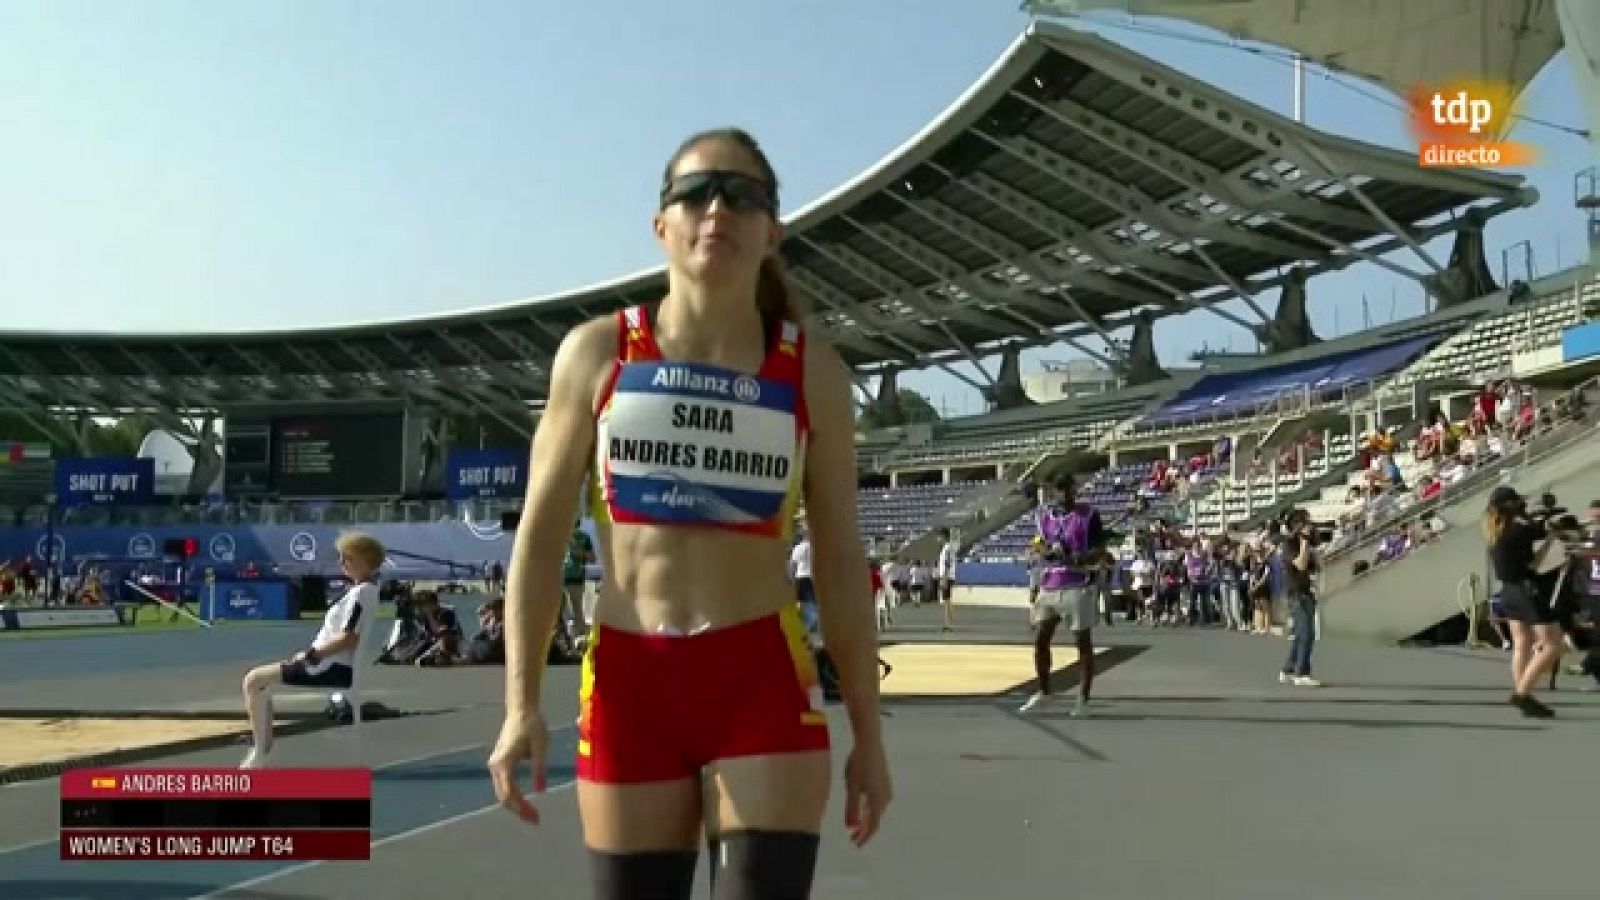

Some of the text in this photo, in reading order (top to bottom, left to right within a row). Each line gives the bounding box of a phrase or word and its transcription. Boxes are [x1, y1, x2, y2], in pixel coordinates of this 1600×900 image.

[652, 366, 729, 394] Allianz
[672, 402, 733, 433] SARA
[610, 438, 788, 480] ANDRES BARRIO
[69, 474, 106, 491] SHOT
[459, 467, 490, 485] SHOT
